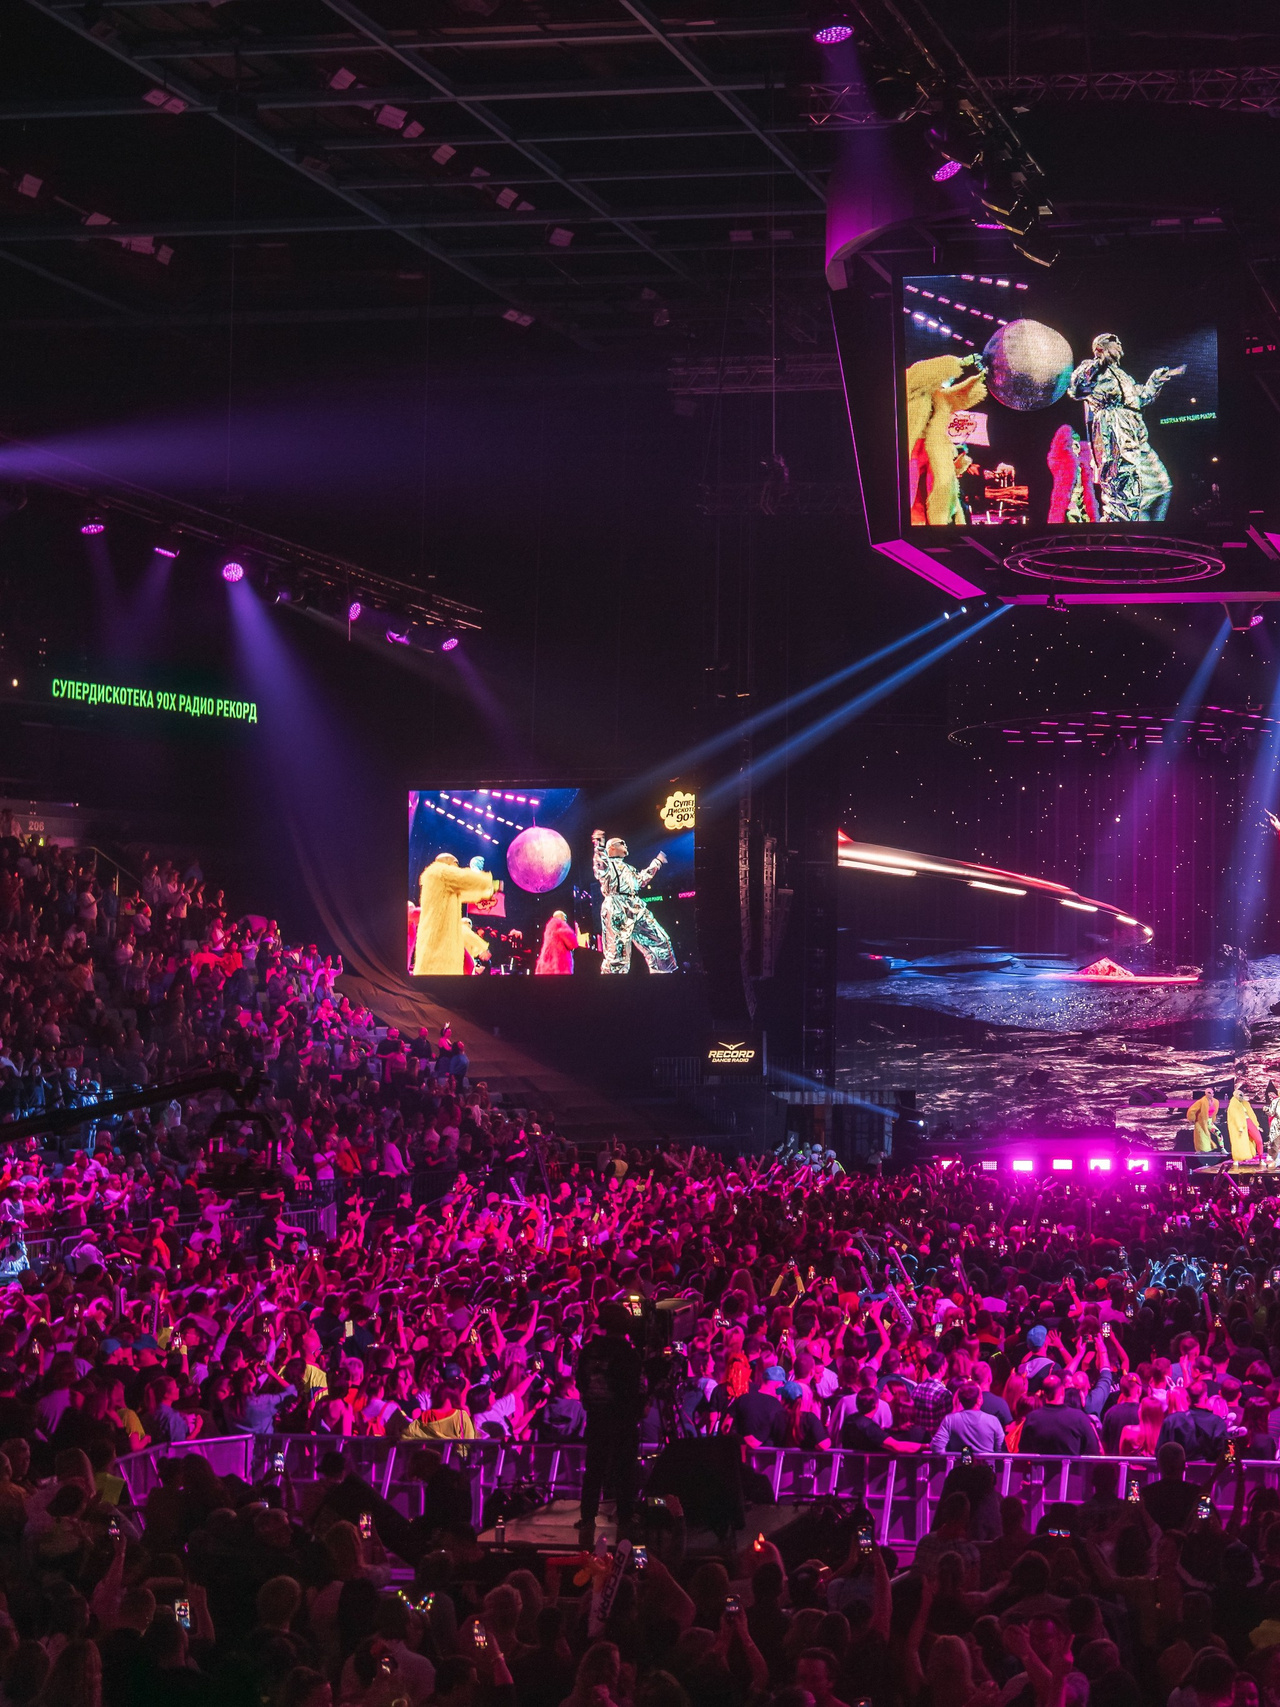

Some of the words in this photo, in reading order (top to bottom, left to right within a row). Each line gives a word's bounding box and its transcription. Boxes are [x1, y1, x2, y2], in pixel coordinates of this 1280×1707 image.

[52, 678, 154, 709] СУПЕРДИСКОТЕКА
[156, 691, 177, 712] 90Х
[179, 694, 214, 717] РАДИО
[216, 699, 258, 724] РЕКОРД
[29, 821, 45, 831] 206
[708, 1050, 755, 1058] RECORD
